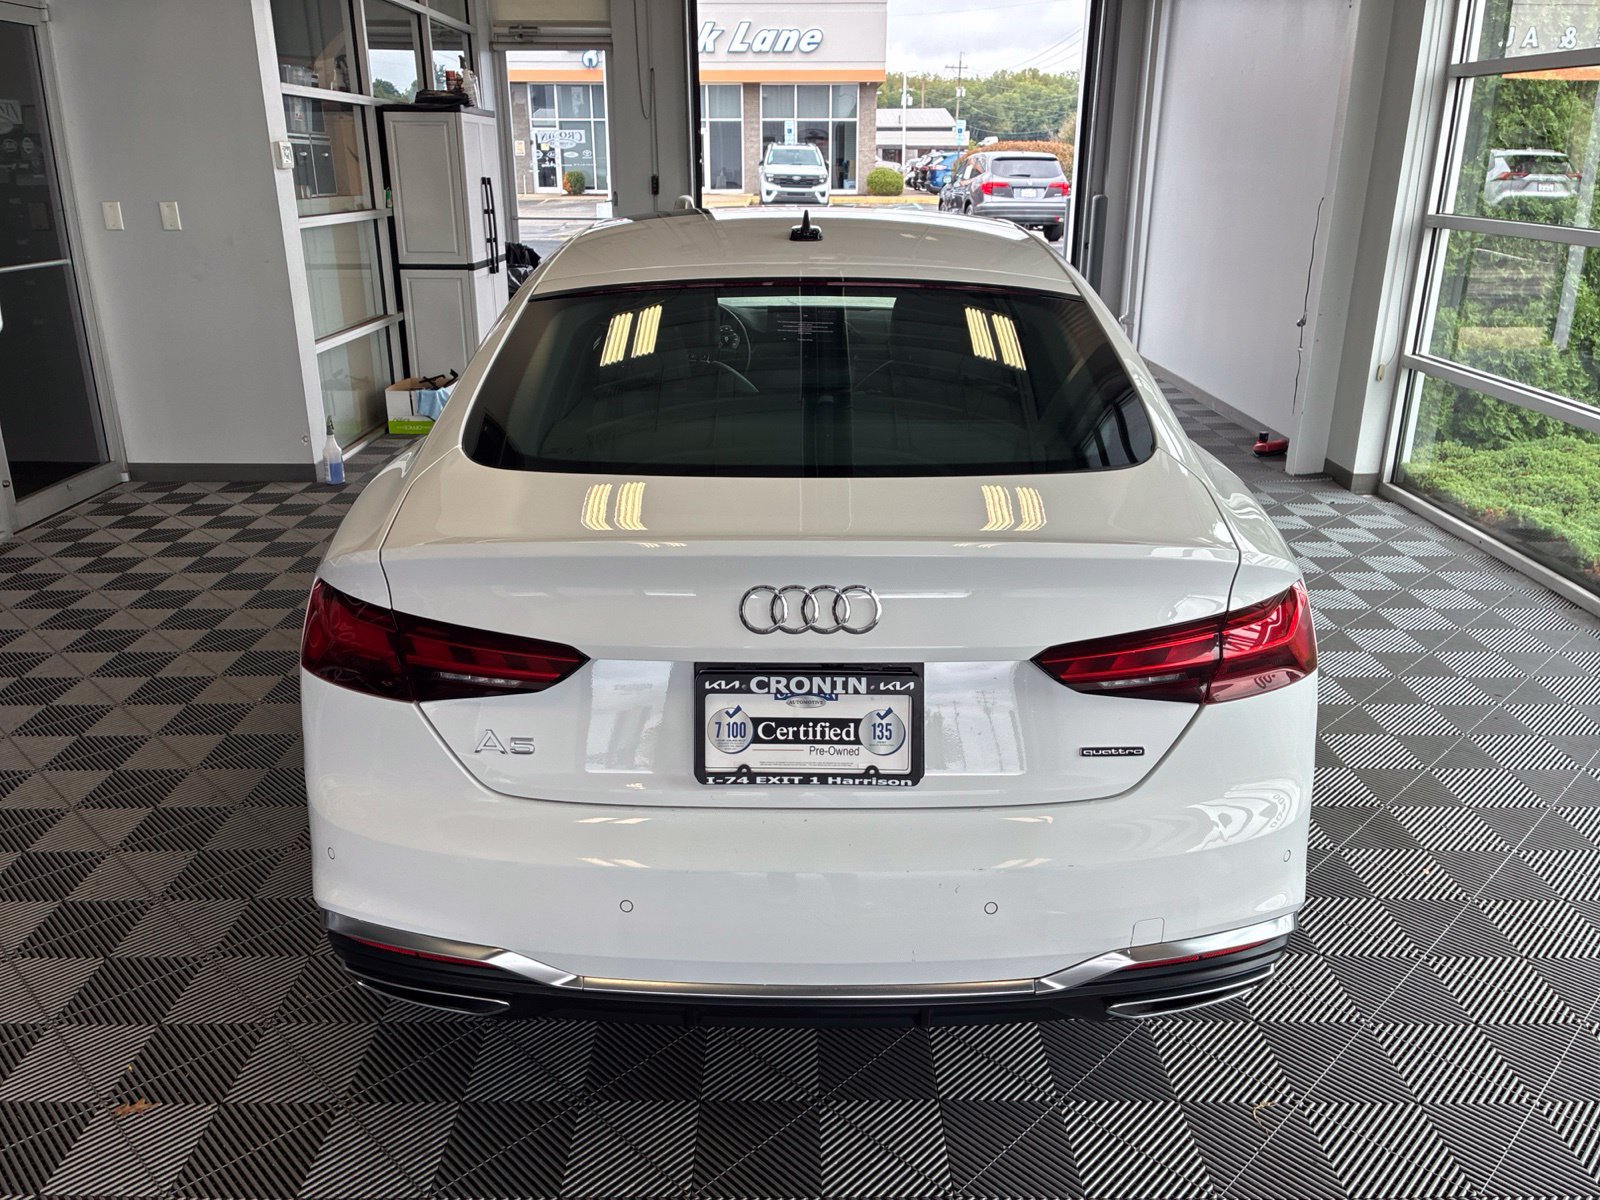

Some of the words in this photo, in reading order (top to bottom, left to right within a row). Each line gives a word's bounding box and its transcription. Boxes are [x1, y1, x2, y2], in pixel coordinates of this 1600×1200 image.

[727, 21, 824, 54] Lane
[749, 676, 867, 694] CRONIN
[715, 721, 722, 739] 7
[726, 721, 747, 739] 100
[757, 721, 856, 741] Certified
[871, 722, 893, 741] 135
[474, 728, 536, 755] A5
[809, 746, 860, 756] Pre-Owned
[1082, 748, 1143, 756] quattro
[706, 776, 750, 784] I-74
[756, 776, 803, 784] EXIT
[809, 777, 821, 785] 1
[828, 776, 912, 786] Harrison
